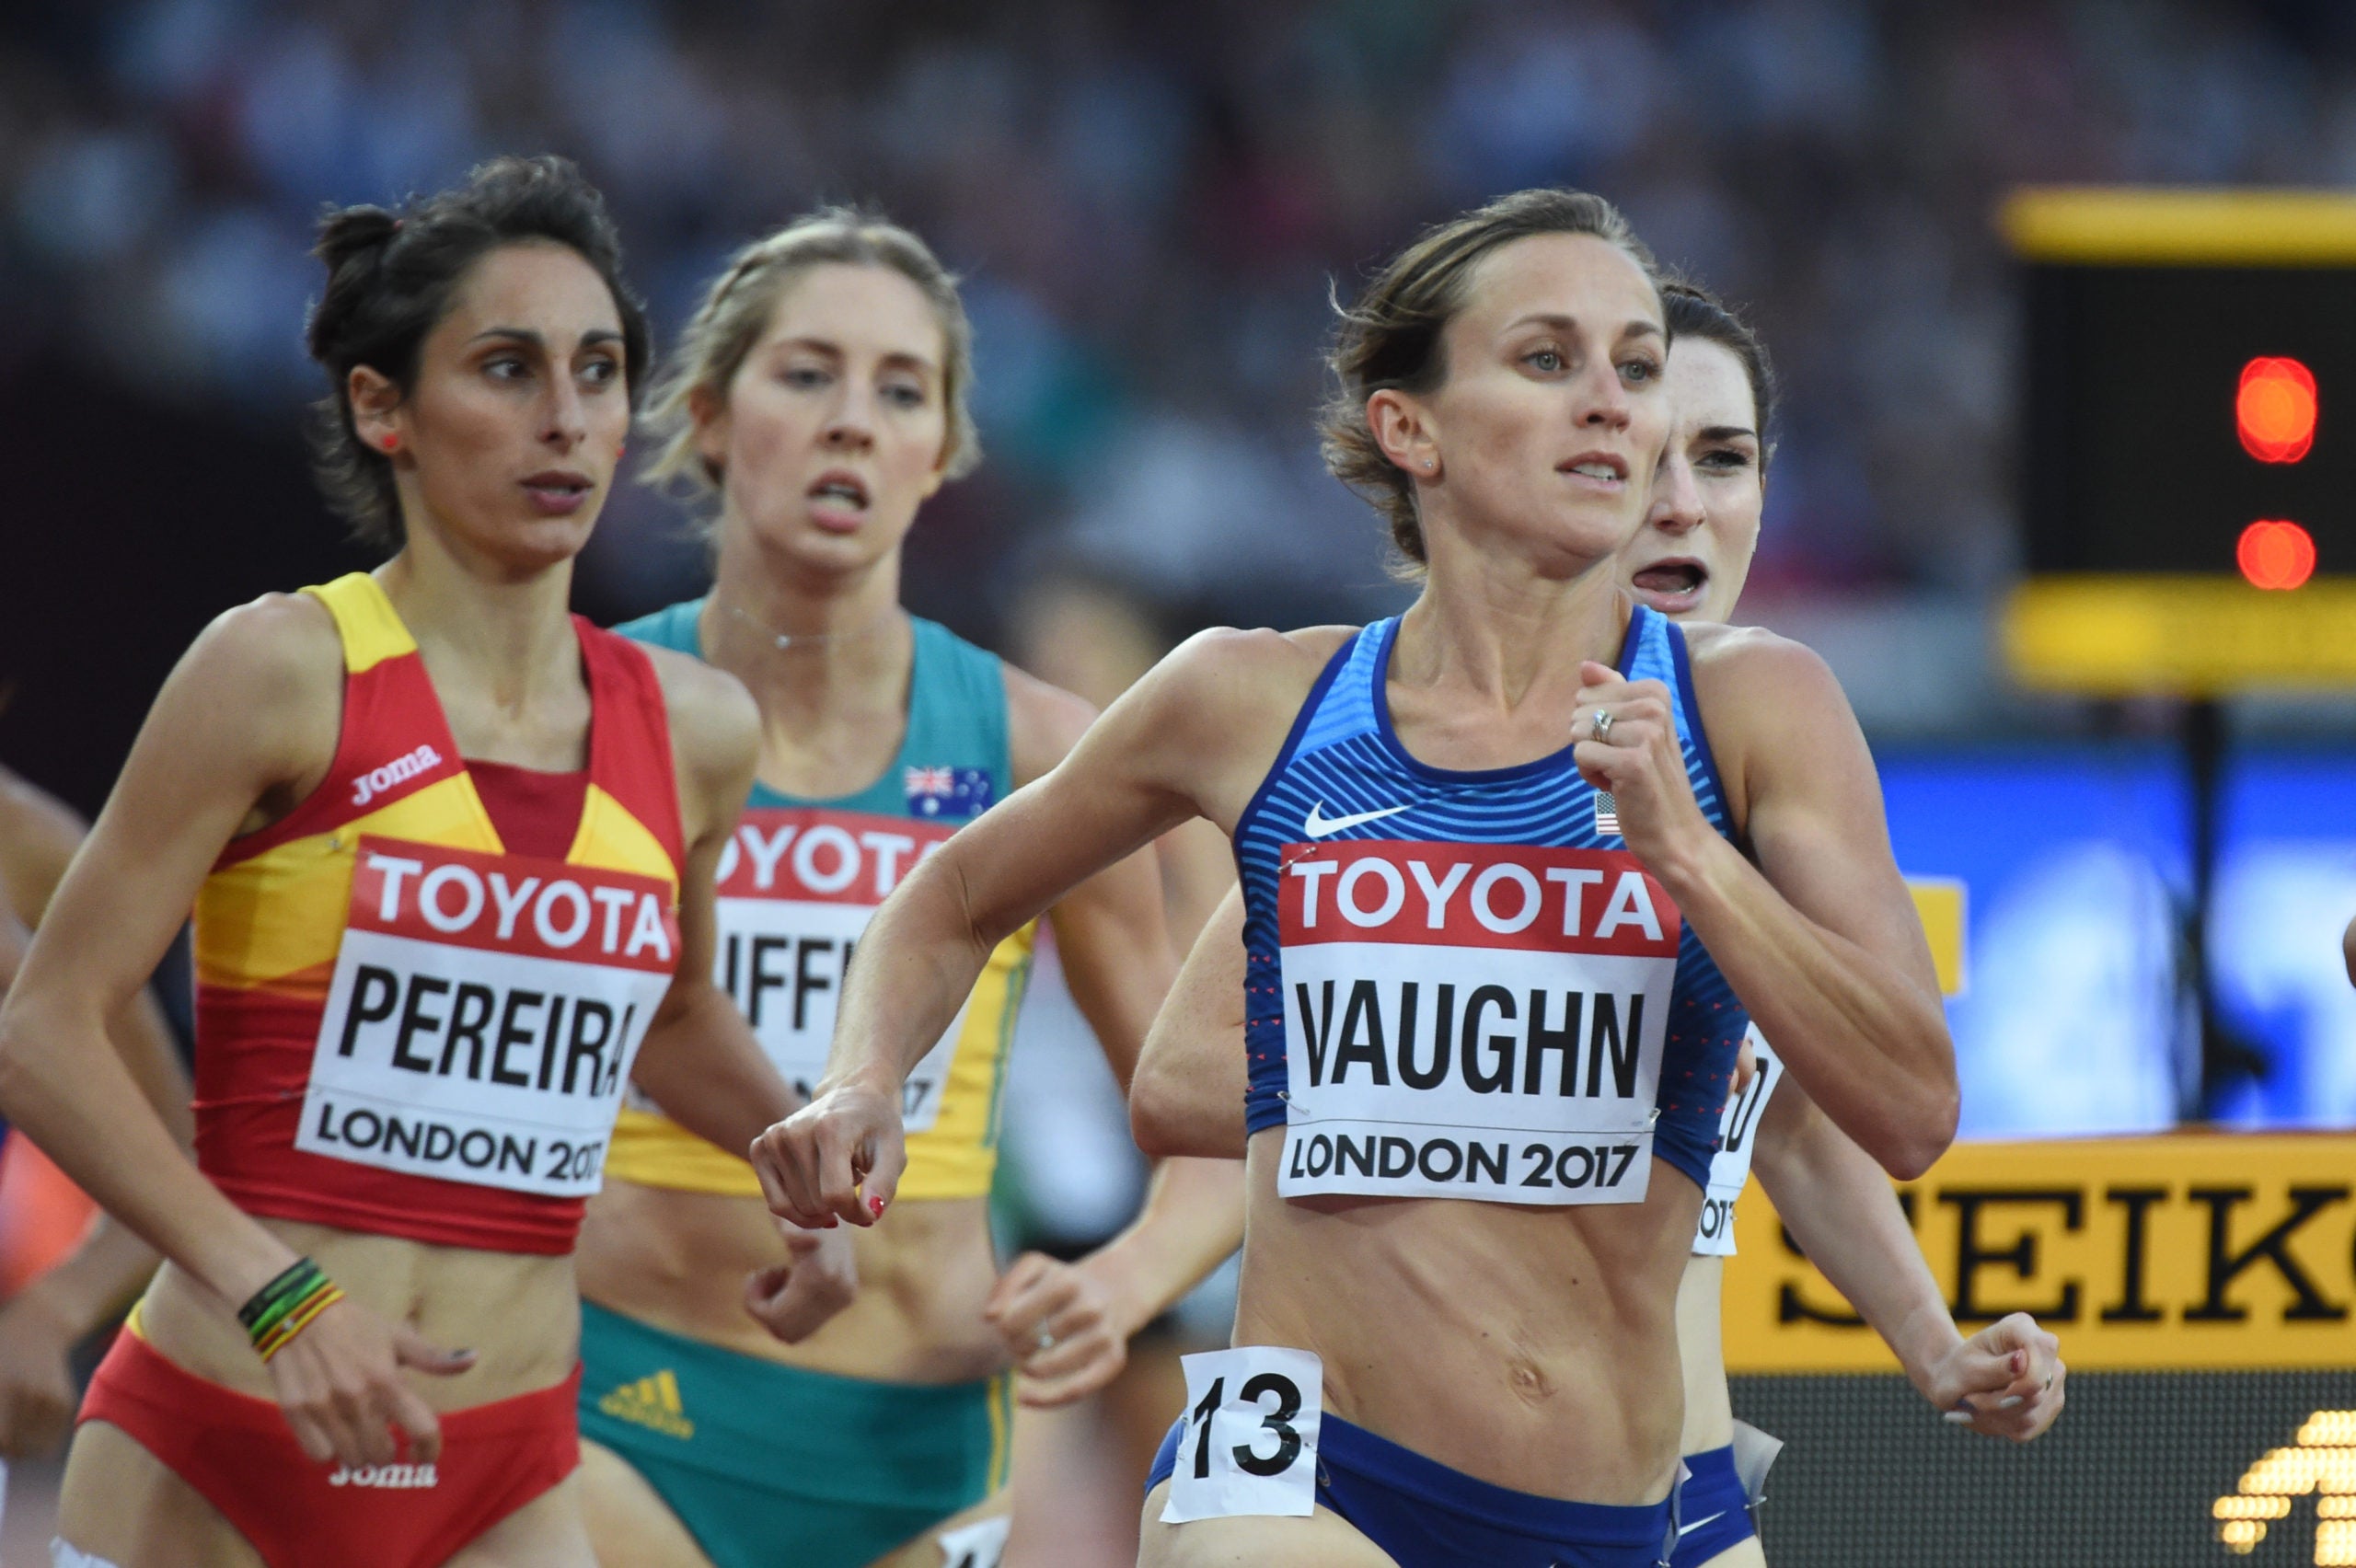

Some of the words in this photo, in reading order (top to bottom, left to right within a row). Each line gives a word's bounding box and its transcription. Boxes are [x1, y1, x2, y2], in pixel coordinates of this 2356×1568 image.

[352, 744, 442, 806] Joma
[368, 852, 672, 962] TOYOTA
[716, 823, 945, 896] YOT
[1289, 857, 1665, 940] TOYOTA
[338, 963, 637, 1098] PEREIRA
[725, 933, 855, 1031] IFF
[1295, 979, 1646, 1099] VAUGHN
[317, 1102, 537, 1176] LONDON
[1289, 1133, 1510, 1185] LONDON
[1519, 1142, 1640, 1189] 2017
[1778, 1186, 2356, 1324] EIK
[1193, 1372, 1302, 1480] 13
